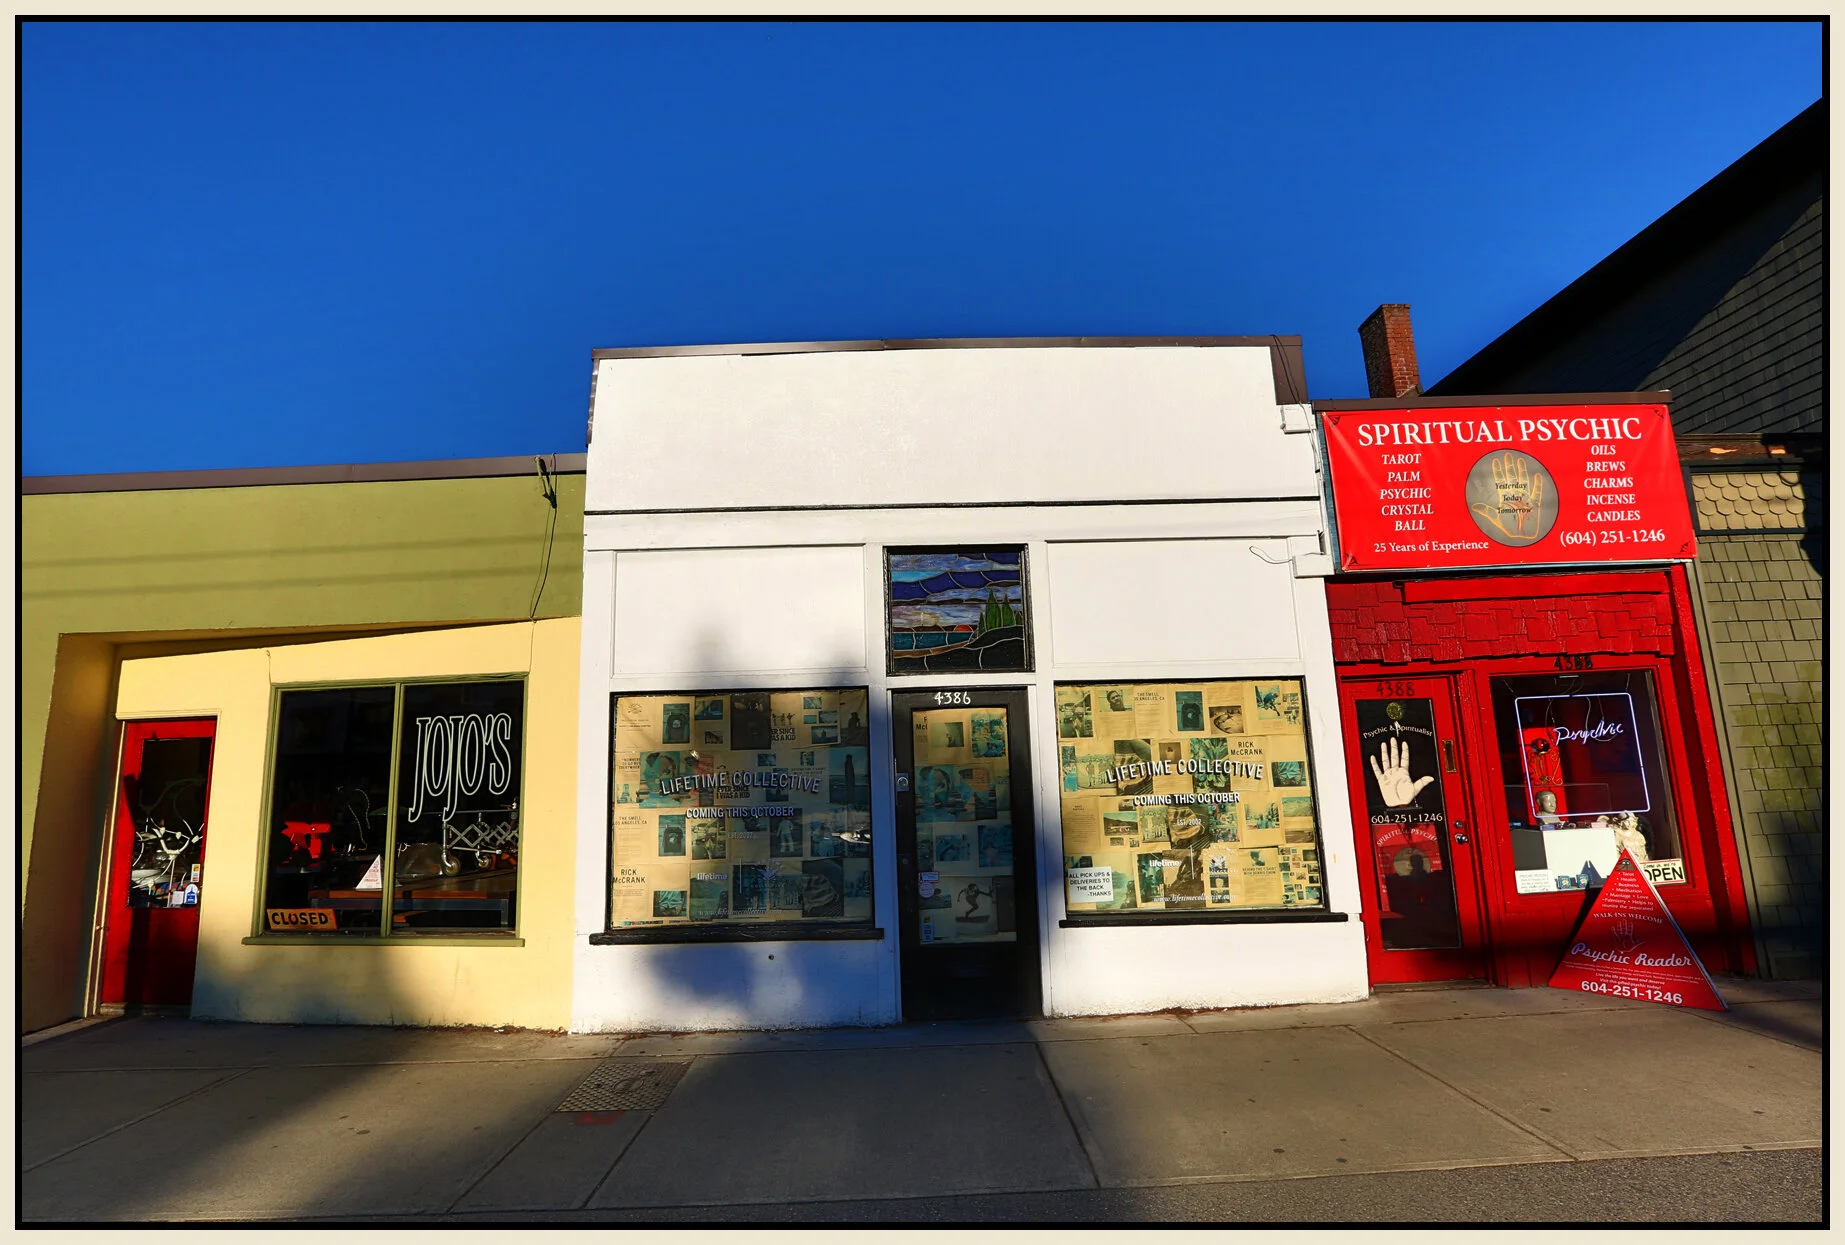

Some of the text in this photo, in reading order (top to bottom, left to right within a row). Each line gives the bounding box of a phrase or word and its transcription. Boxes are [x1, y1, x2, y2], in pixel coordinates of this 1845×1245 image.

[1358, 417, 1642, 446] SPIRITUAL PSYCHIC
[1591, 445, 1616, 456] OILS
[1382, 453, 1422, 465] TAROT
[1586, 461, 1626, 472] BREWS
[1387, 471, 1421, 483] PALM
[1583, 477, 1634, 489] CHARMS
[1495, 482, 1527, 491] Yesterday
[1380, 487, 1432, 500] PSYCHIC
[1503, 494, 1523, 503] Today
[1586, 494, 1636, 506] INCENSE
[1381, 504, 1434, 516] CRYSTAL
[1497, 506, 1532, 515] Tomorrow
[1587, 510, 1641, 522] CANDLES
[1395, 519, 1426, 531] BALL
[1560, 529, 1665, 547] (604) 251-1246
[1374, 540, 1489, 553] 25 Years of Experience
[1376, 681, 1415, 697] 4388
[934, 691, 971, 705] 4386
[1363, 725, 1388, 738] Psychic
[1553, 720, 1624, 746] Psychic
[1230, 748, 1263, 756] McCRANK
[408, 713, 512, 822] JOJO'S
[1106, 758, 1264, 783] LIFETIME COLLECTIVE
[661, 771, 822, 796] LIFETIME COLLECTIVE
[1134, 792, 1240, 806] COMING THIS OCTOBER
[686, 806, 794, 819] COMING THIS OCTOBER
[1371, 812, 1443, 824] 604-251-1246
[1410, 828, 1438, 842] PSYCHI
[620, 868, 637, 876] RICK
[613, 876, 646, 884] McCRANK
[271, 911, 329, 925] CLOSED
[1593, 911, 1663, 924] WALK-INS WELCOME
[1571, 942, 1692, 967] Psychic Reader
[1581, 980, 1683, 1005] 604-251-1246
